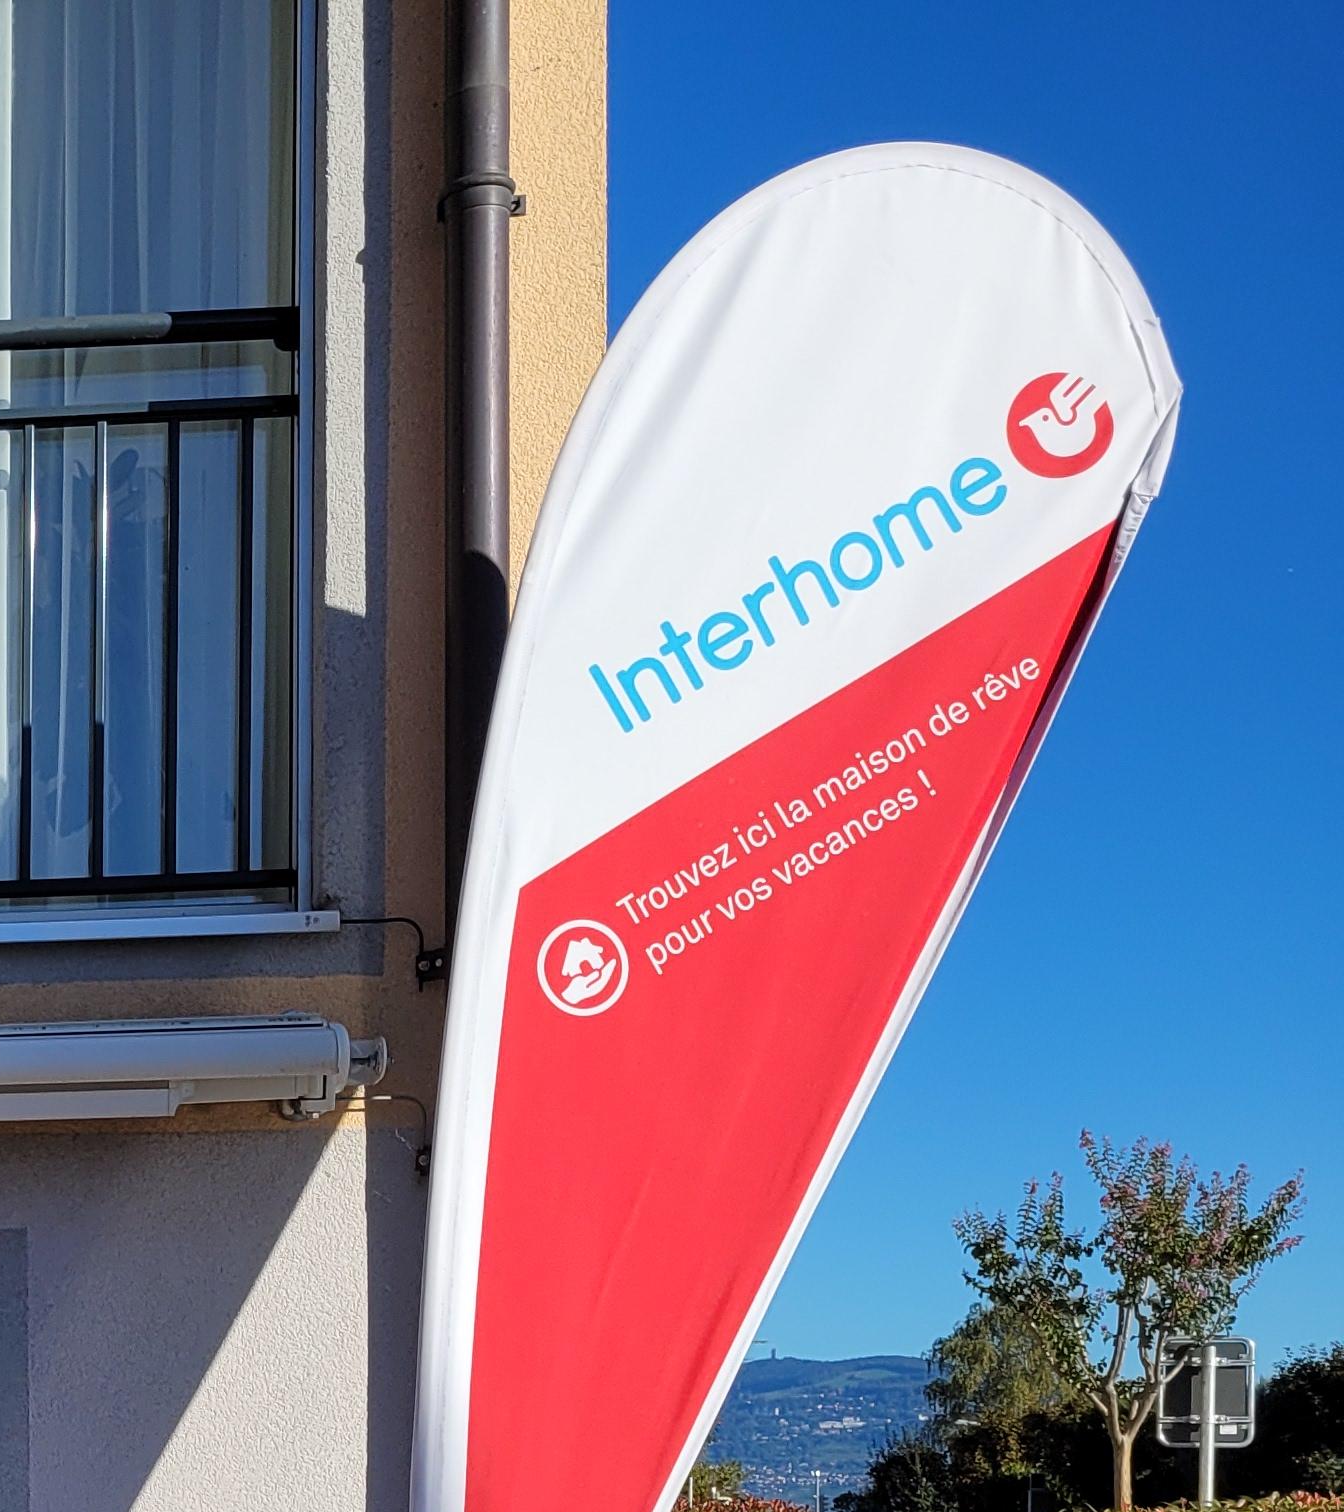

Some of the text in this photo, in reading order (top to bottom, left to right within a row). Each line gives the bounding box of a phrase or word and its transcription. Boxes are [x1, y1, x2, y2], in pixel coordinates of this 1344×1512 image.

[589, 457, 1007, 733] Interhome
[616, 655, 1041, 927] Trouvez ici la maison de rêve
[644, 912, 714, 974] pour
[716, 873, 773, 922] vos
[771, 788, 919, 886] vacances
